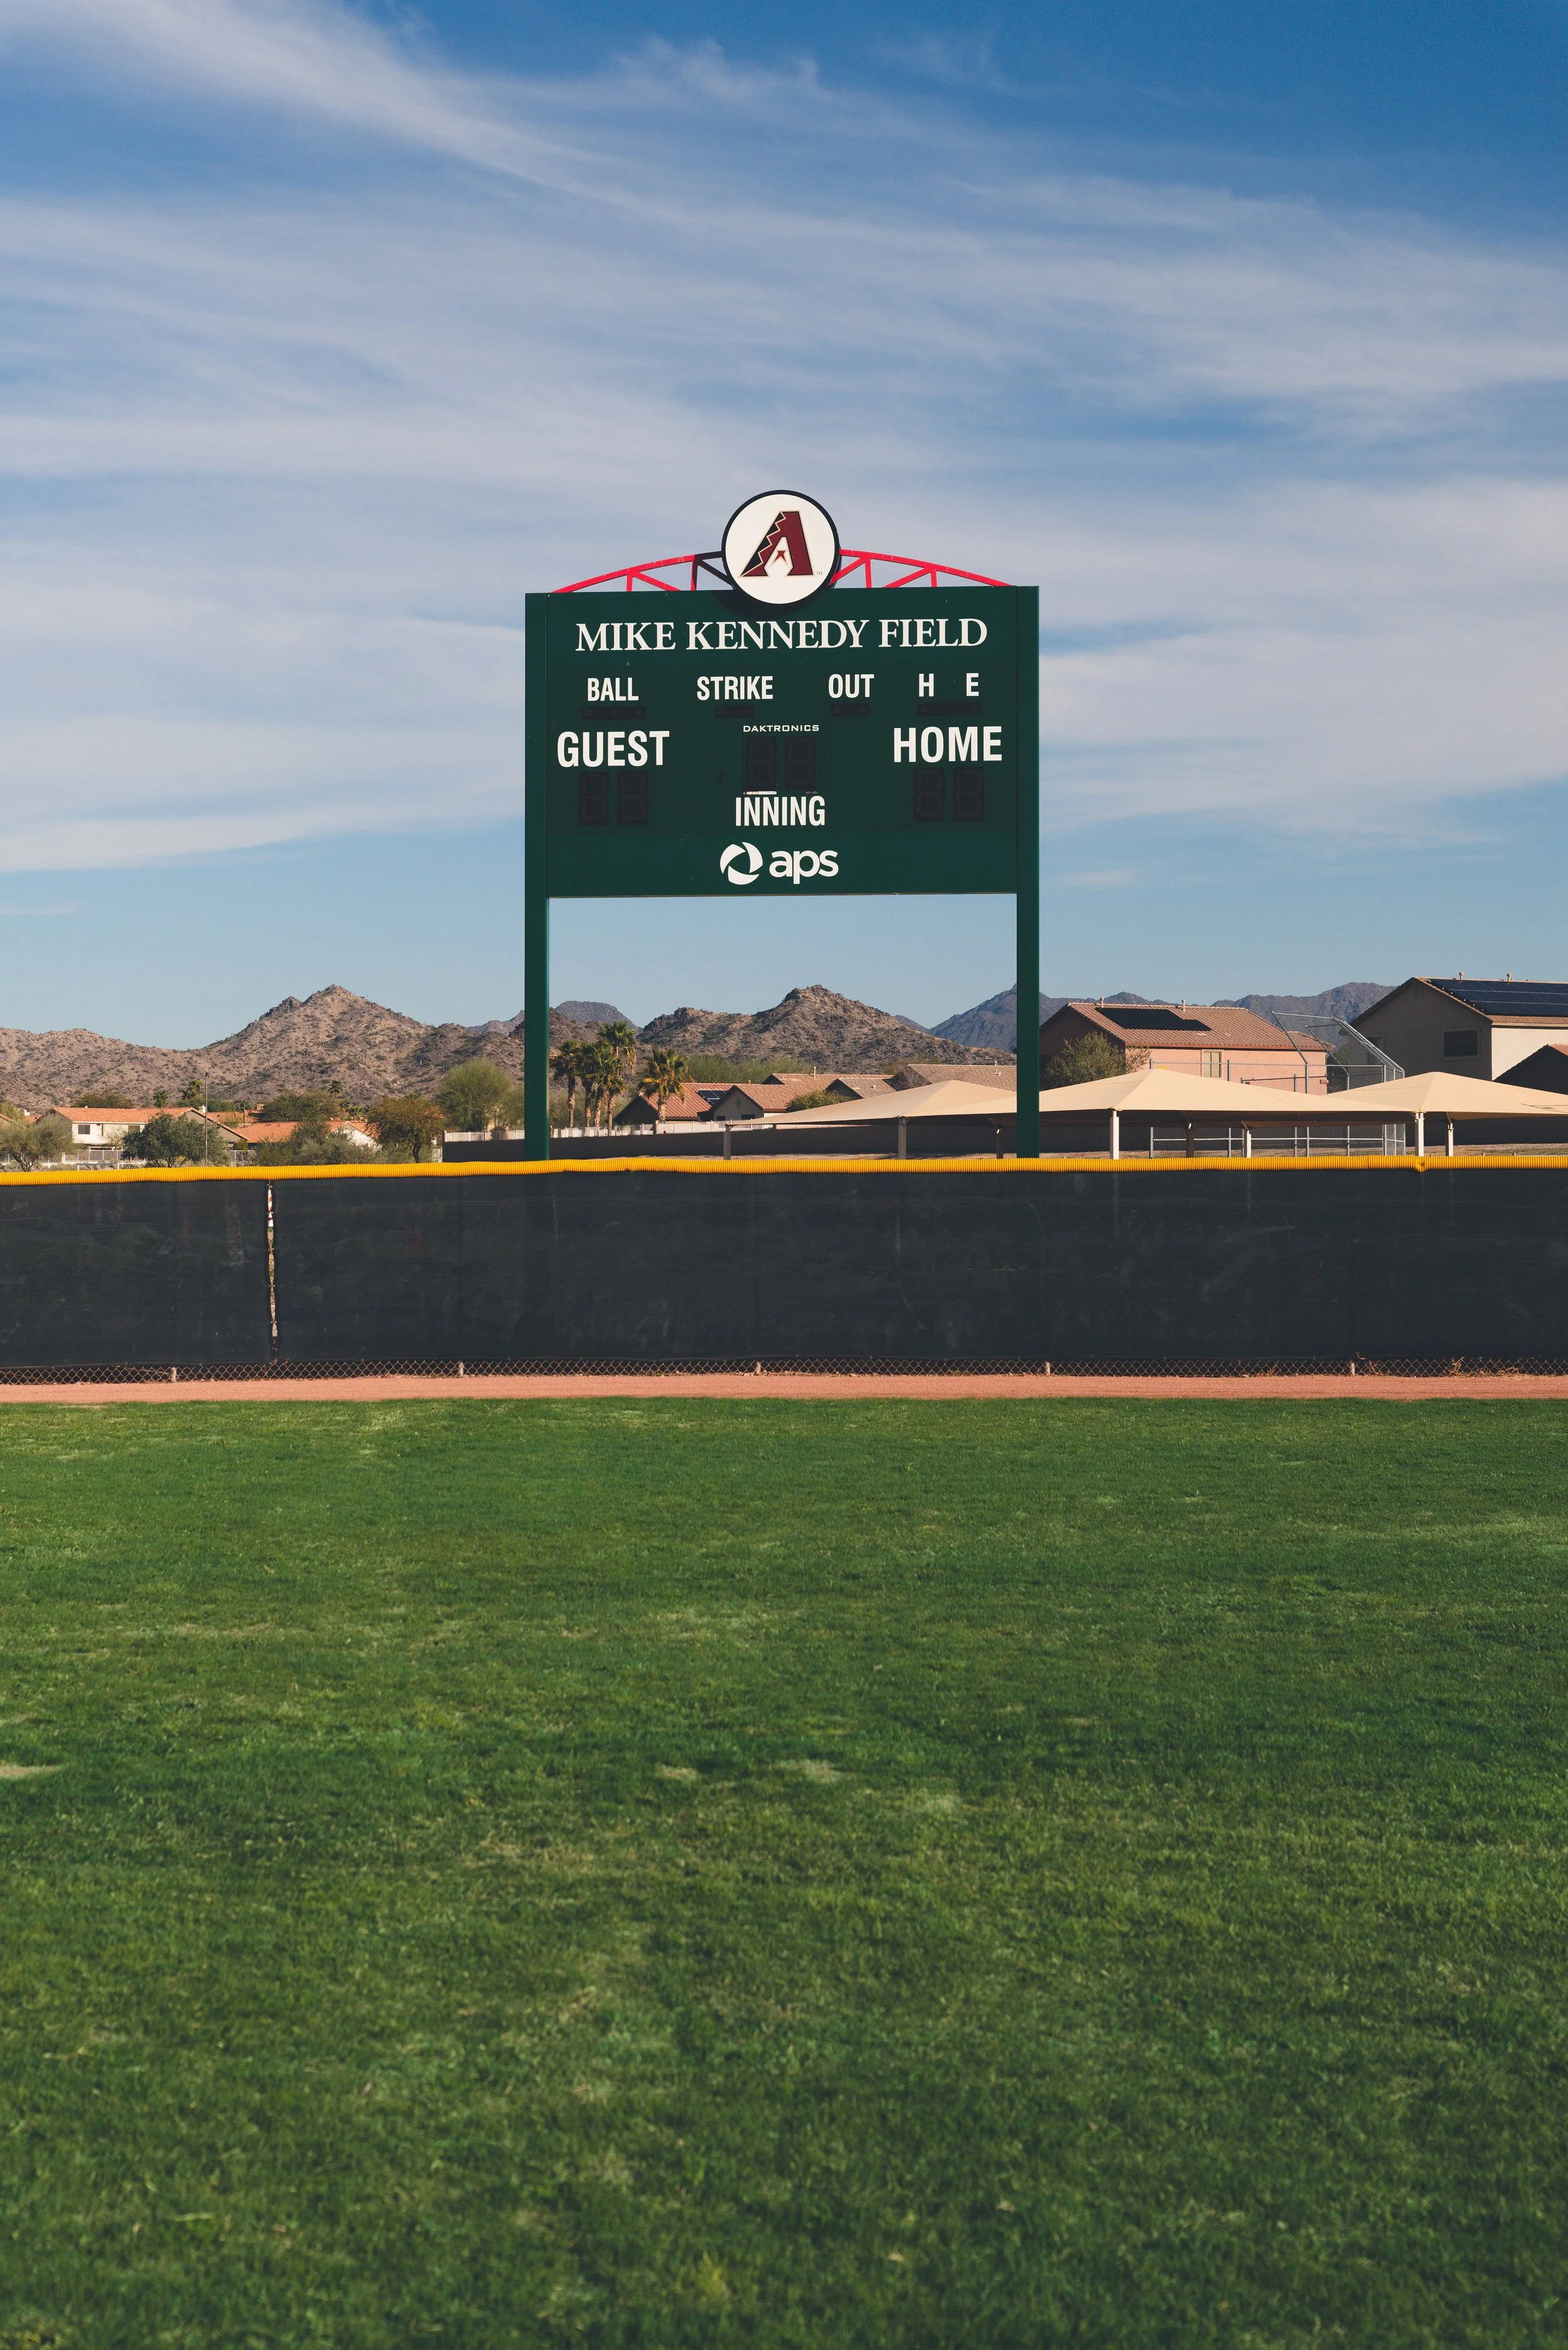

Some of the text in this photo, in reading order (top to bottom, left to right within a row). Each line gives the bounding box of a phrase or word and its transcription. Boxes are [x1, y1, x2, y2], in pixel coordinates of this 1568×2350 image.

[575, 618, 987, 651] MIKE KENNEDY FIELD
[587, 677, 639, 701] BALL
[697, 676, 773, 701] STRIKE
[828, 673, 875, 699] OUT
[918, 673, 935, 697] H
[966, 673, 980, 697] E
[743, 725, 819, 733] DAKTRONICS
[557, 730, 670, 768] GUEST
[894, 726, 1002, 763] HOME
[735, 795, 825, 826] INNING
[769, 849, 839, 885] aps
